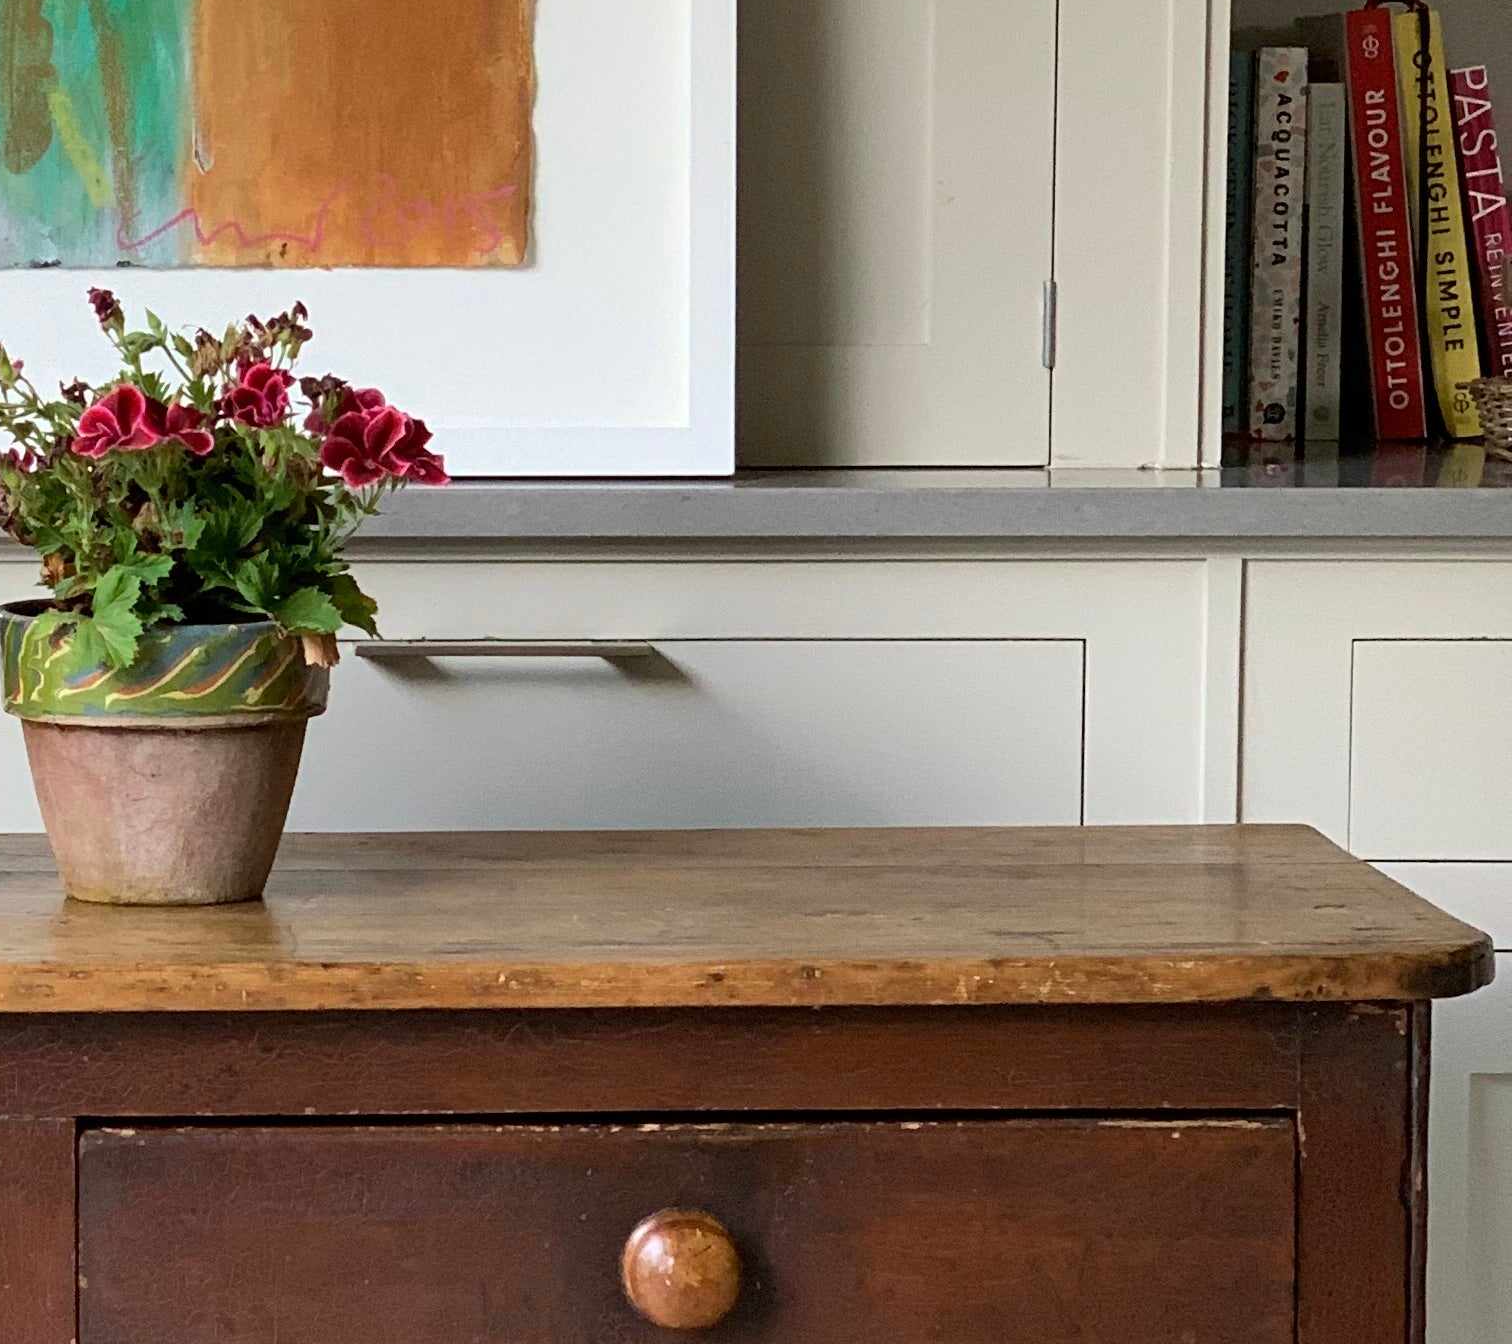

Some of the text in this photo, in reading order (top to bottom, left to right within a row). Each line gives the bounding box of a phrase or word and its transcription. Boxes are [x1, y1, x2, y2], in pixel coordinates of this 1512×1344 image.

[1271, 93, 1292, 266] ACQUACOTTA
[1450, 65, 1507, 222] PASTA
[1317, 224, 1334, 274] Glow
[1365, 88, 1410, 410] OTTOLENGHI FLAVOUR
[1434, 251, 1464, 352] SIMPLE
